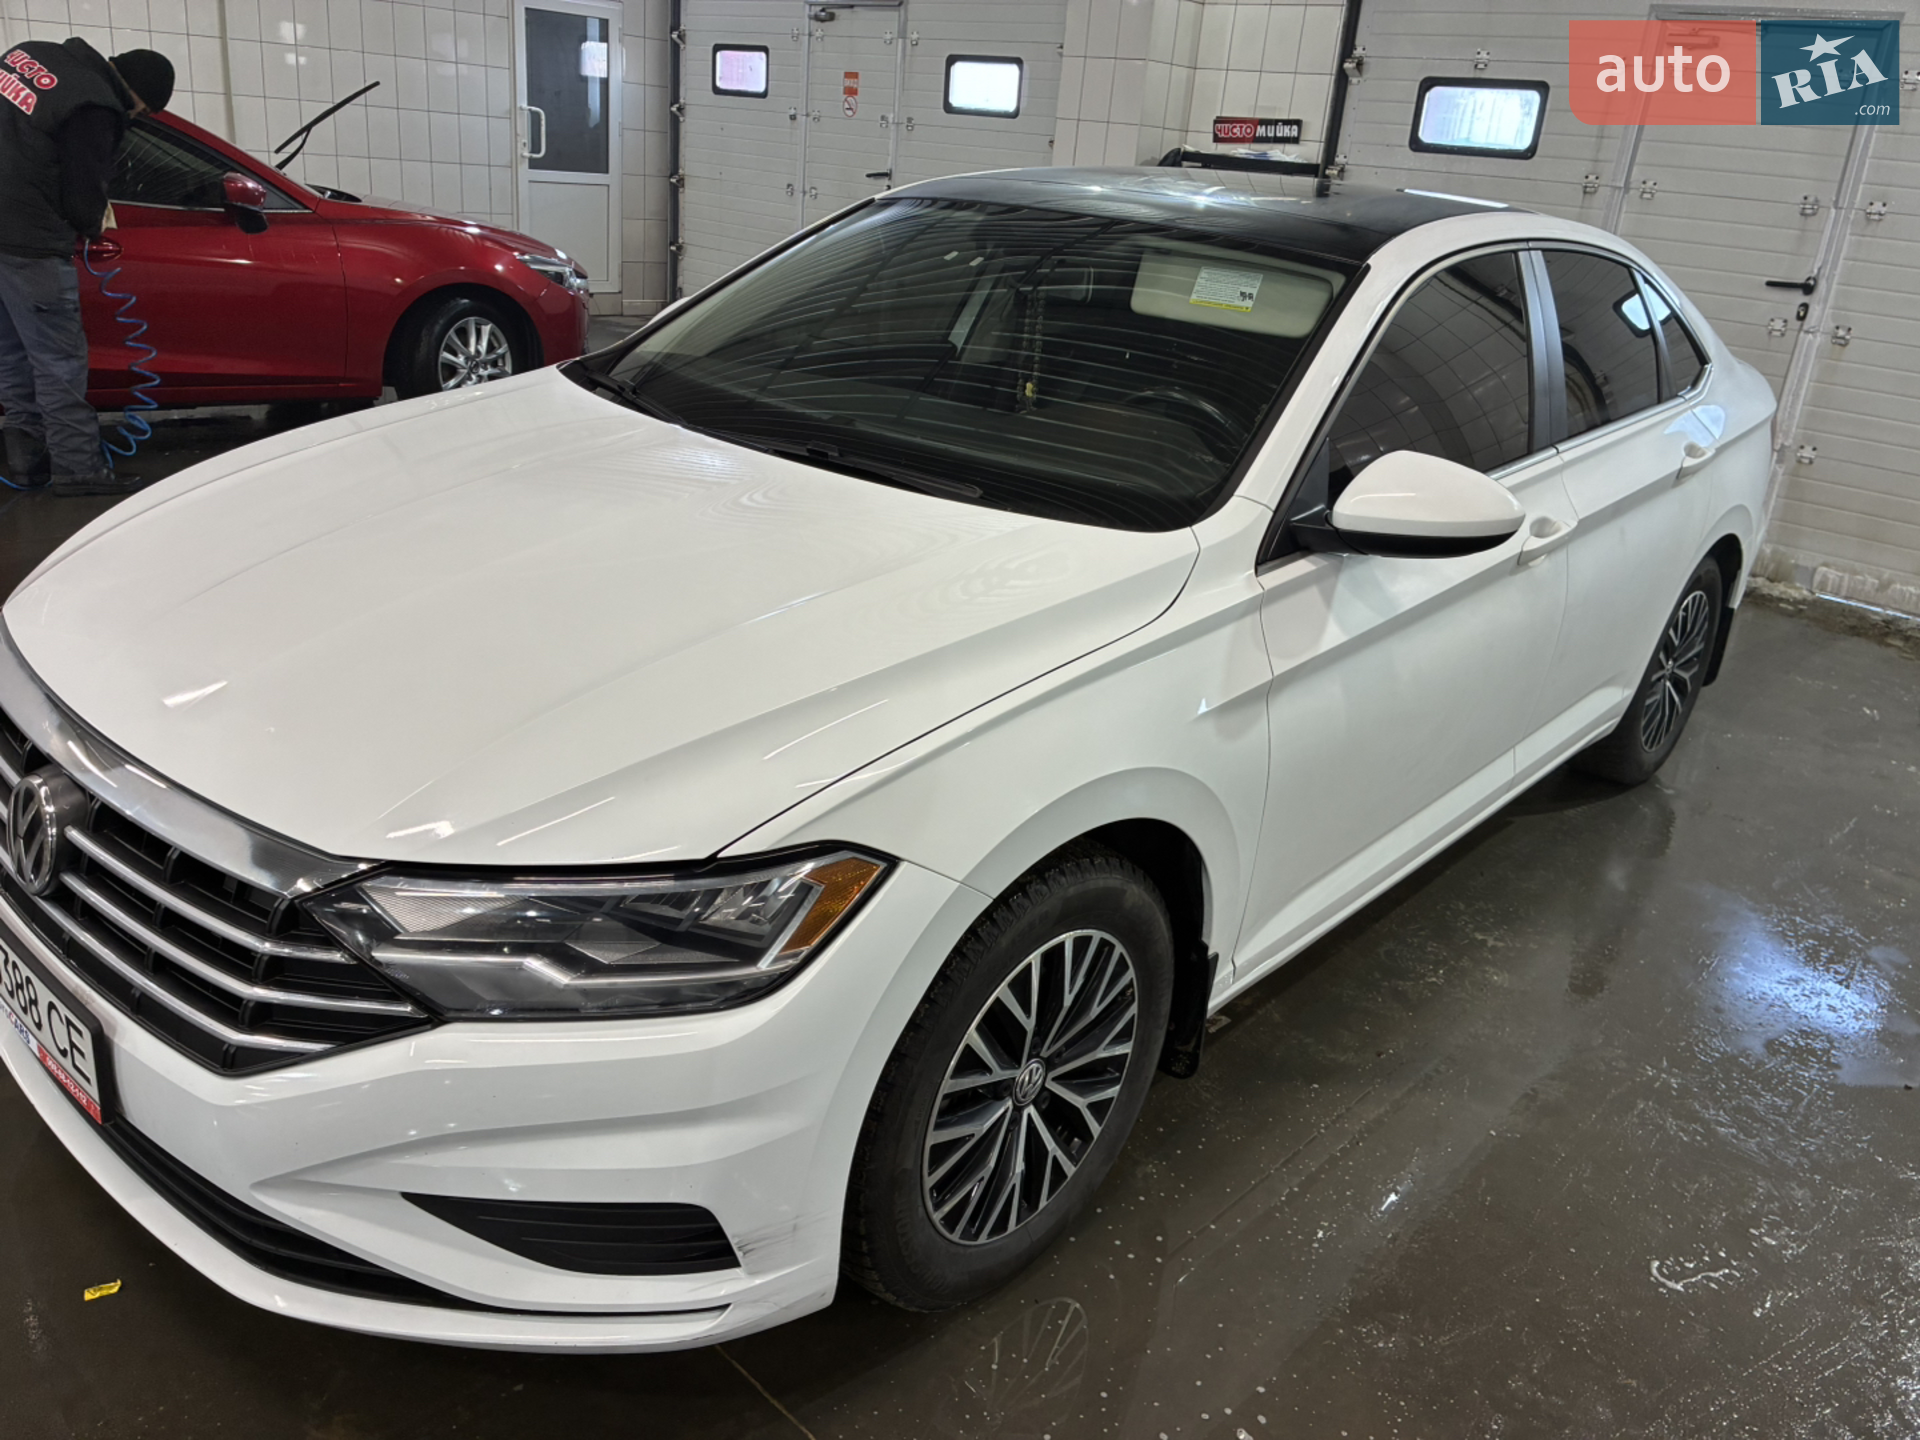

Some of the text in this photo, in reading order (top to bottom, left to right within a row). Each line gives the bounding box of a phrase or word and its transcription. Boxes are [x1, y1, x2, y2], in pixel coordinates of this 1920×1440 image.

[1215, 122, 1299, 138] ЧИСТО МИЙКА
[0, 944, 91, 1085] 388 CE
